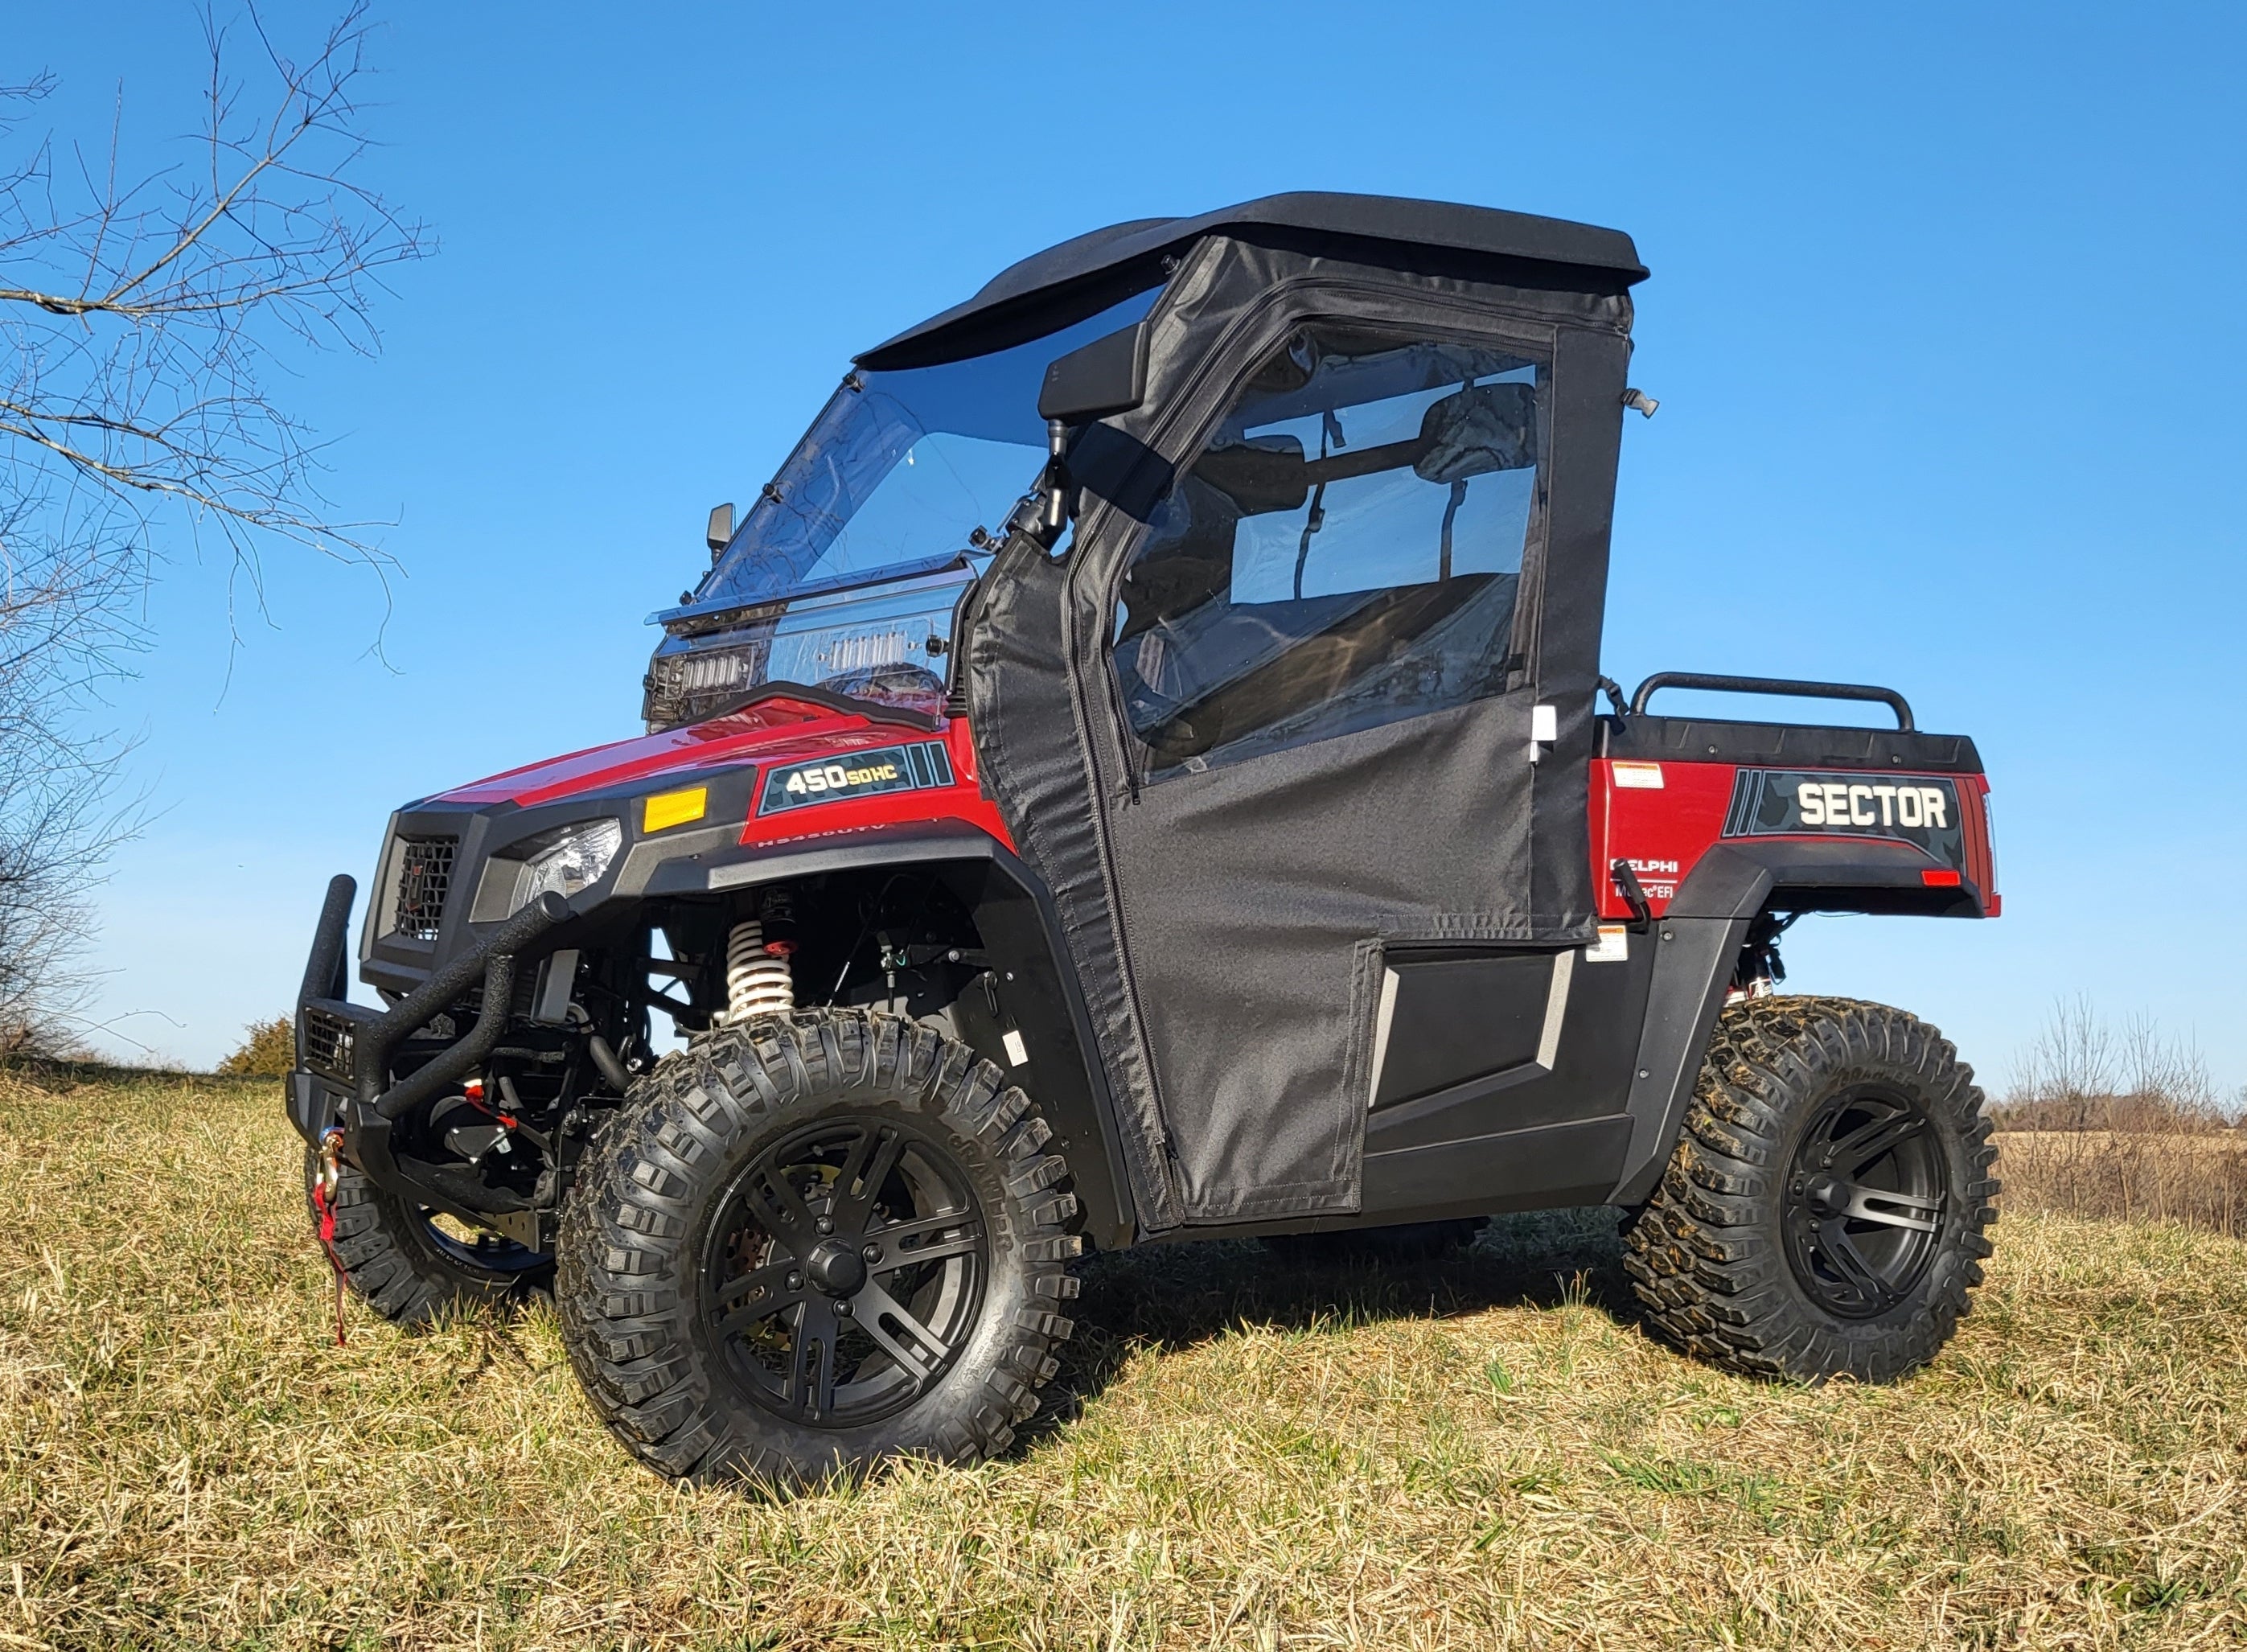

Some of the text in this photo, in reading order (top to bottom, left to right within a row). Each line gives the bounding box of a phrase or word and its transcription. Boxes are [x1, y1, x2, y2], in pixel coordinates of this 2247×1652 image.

[786, 764, 898, 794] 450 SOHC
[1797, 783, 1948, 828] SECTOR
[758, 824, 885, 848] HS450UTV
[1658, 886, 1673, 898] EFI
